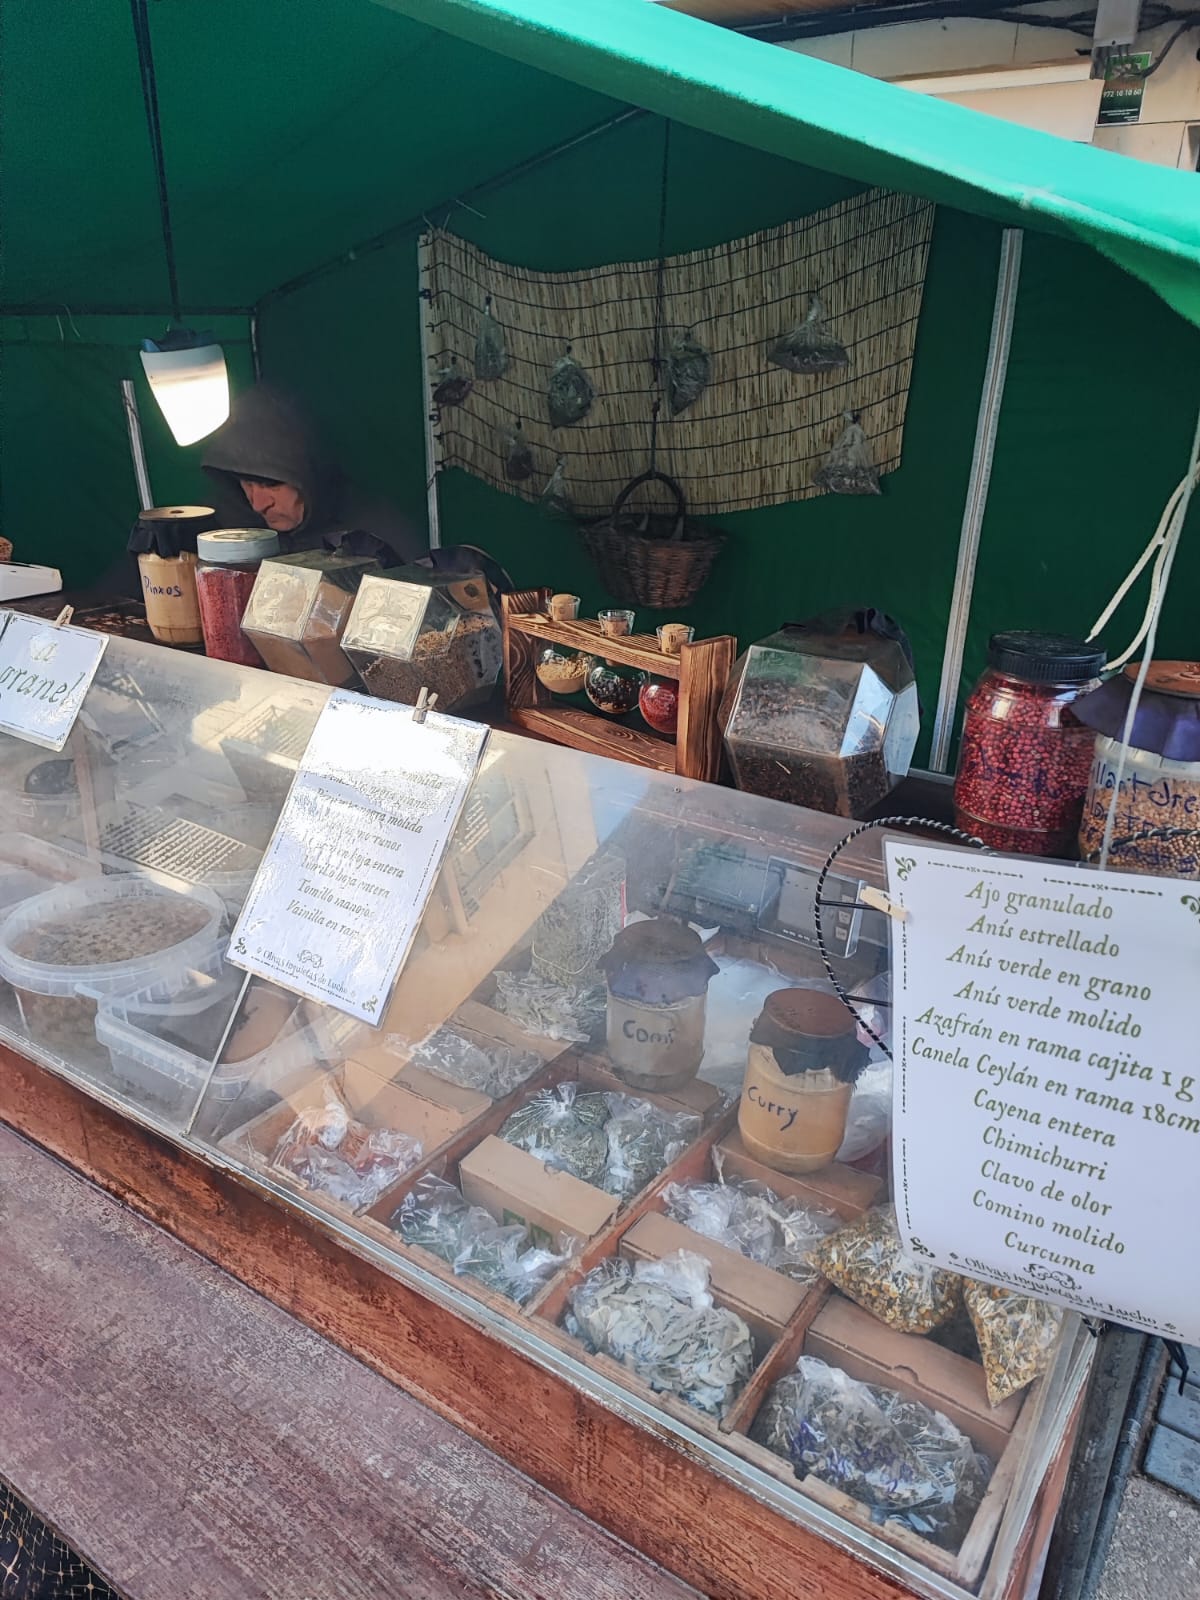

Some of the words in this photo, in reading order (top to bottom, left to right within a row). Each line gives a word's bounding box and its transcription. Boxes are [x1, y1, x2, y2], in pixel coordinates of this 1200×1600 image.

[143, 576, 182, 598] Pinxos
[387, 813, 424, 834] molida
[297, 878, 334, 903] Tomillo
[372, 861, 405, 879] entera
[285, 899, 326, 925] Vainilla
[325, 920, 338, 931] en
[965, 881, 1000, 908] Ajo
[1004, 892, 1113, 919] granulado
[967, 914, 1013, 938] Anís
[1019, 926, 1120, 957] estrellado
[946, 944, 992, 968] Anís
[998, 958, 1052, 981] verde
[1057, 970, 1081, 987] en
[1083, 975, 1152, 1001] grano
[953, 980, 1001, 1005] Anís
[1006, 996, 1061, 1019] verde
[1067, 1008, 1142, 1038] molido
[911, 1037, 970, 1068] Canela
[976, 1054, 1039, 1089] Ceylán
[1044, 1079, 1068, 1096] en
[1075, 1087, 1134, 1115] rama
[914, 1006, 993, 1038] Azafrán
[998, 1030, 1020, 1047] en
[1026, 1037, 1082, 1062] rama
[1088, 1051, 1153, 1081] cajita
[1175, 1076, 1196, 1102] g
[747, 1086, 799, 1132] Curry
[973, 1088, 1041, 1126] Cayena
[1048, 1115, 1116, 1147] entera
[983, 1125, 1108, 1180] Chimichurri
[981, 1159, 1034, 1192] Clavo
[1040, 1180, 1065, 1202] de
[1071, 1192, 1113, 1217] olor
[972, 1189, 1045, 1228] Comino
[1052, 1220, 1125, 1255] molido
[1004, 1231, 1096, 1275] Curcuma
[965, 1257, 1010, 1280] Olivas
[1086, 1295, 1104, 1309] de
